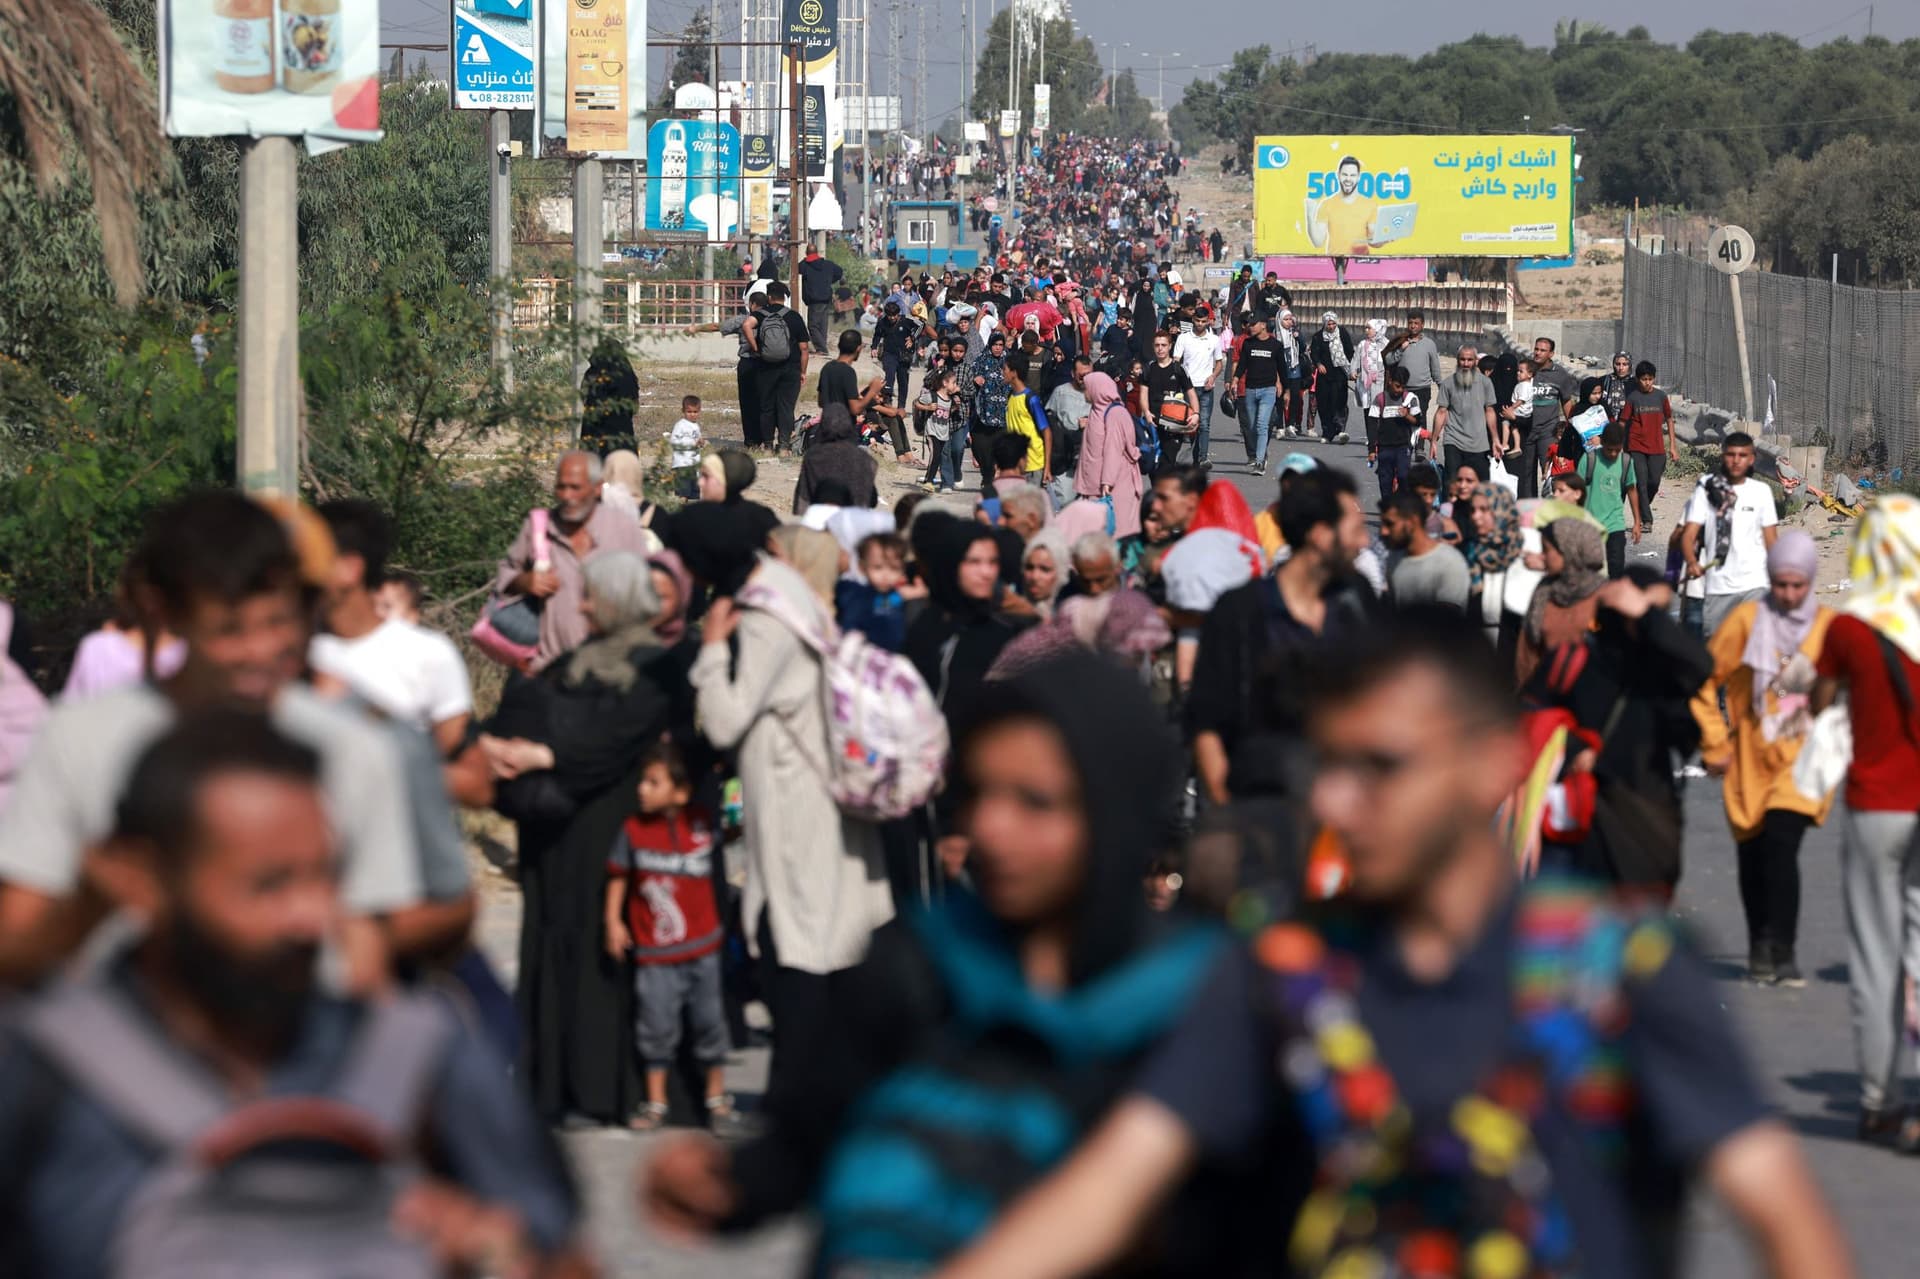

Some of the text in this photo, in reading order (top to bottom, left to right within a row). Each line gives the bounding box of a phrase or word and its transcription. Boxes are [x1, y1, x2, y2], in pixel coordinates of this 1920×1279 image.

[790, 24, 811, 33] Délice
[805, 35, 822, 48] مثيل
[823, 37, 831, 47] لا
[467, 71, 508, 88] منزلي
[1433, 146, 1556, 172] اشبك أوفر نت
[1461, 176, 1557, 200] واربح كاش
[1718, 239, 1742, 263] 40
